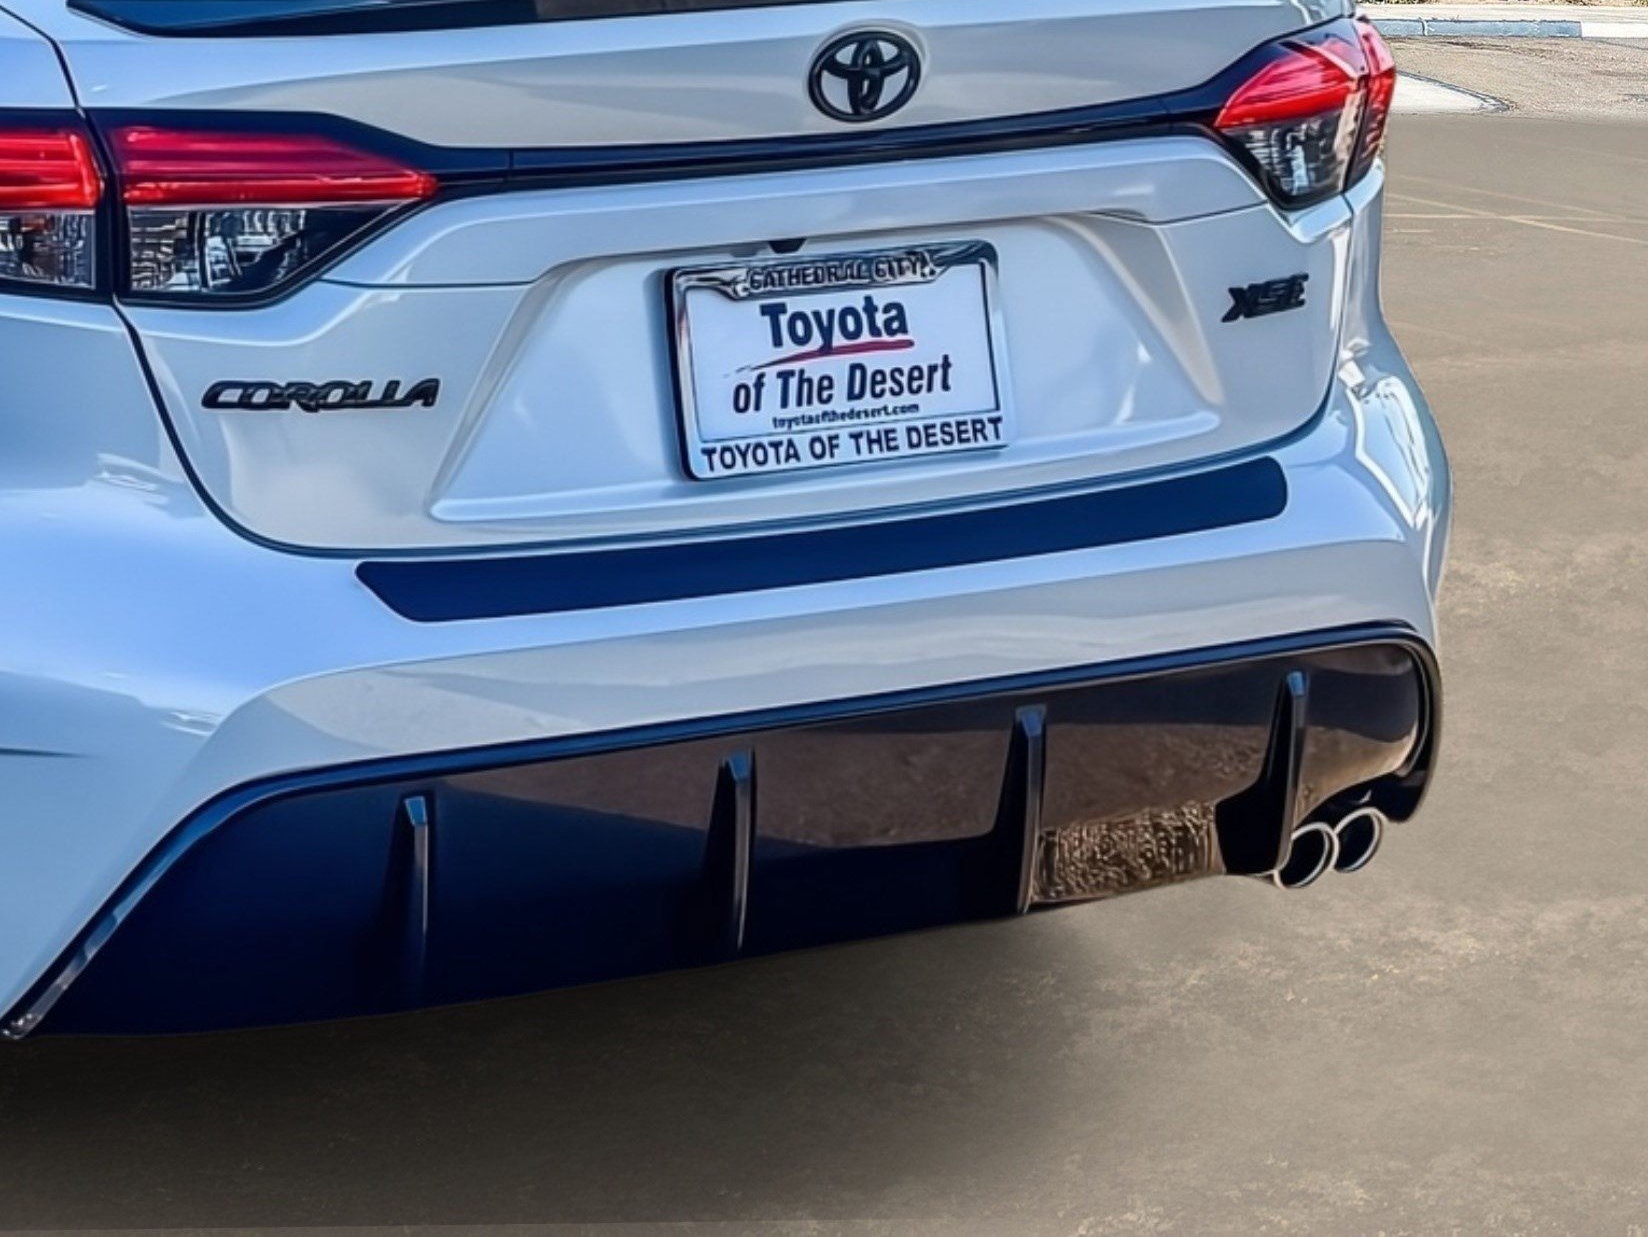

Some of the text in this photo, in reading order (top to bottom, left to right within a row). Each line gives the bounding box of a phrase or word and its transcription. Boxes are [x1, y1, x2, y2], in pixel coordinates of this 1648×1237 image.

[759, 295, 909, 355] Toyota
[201, 378, 441, 413] COROLLA
[732, 354, 952, 414] of The Desert
[701, 416, 1003, 473] TOYOTA OF THE DESERT
[772, 403, 920, 431] toyotaofthedesert.com
